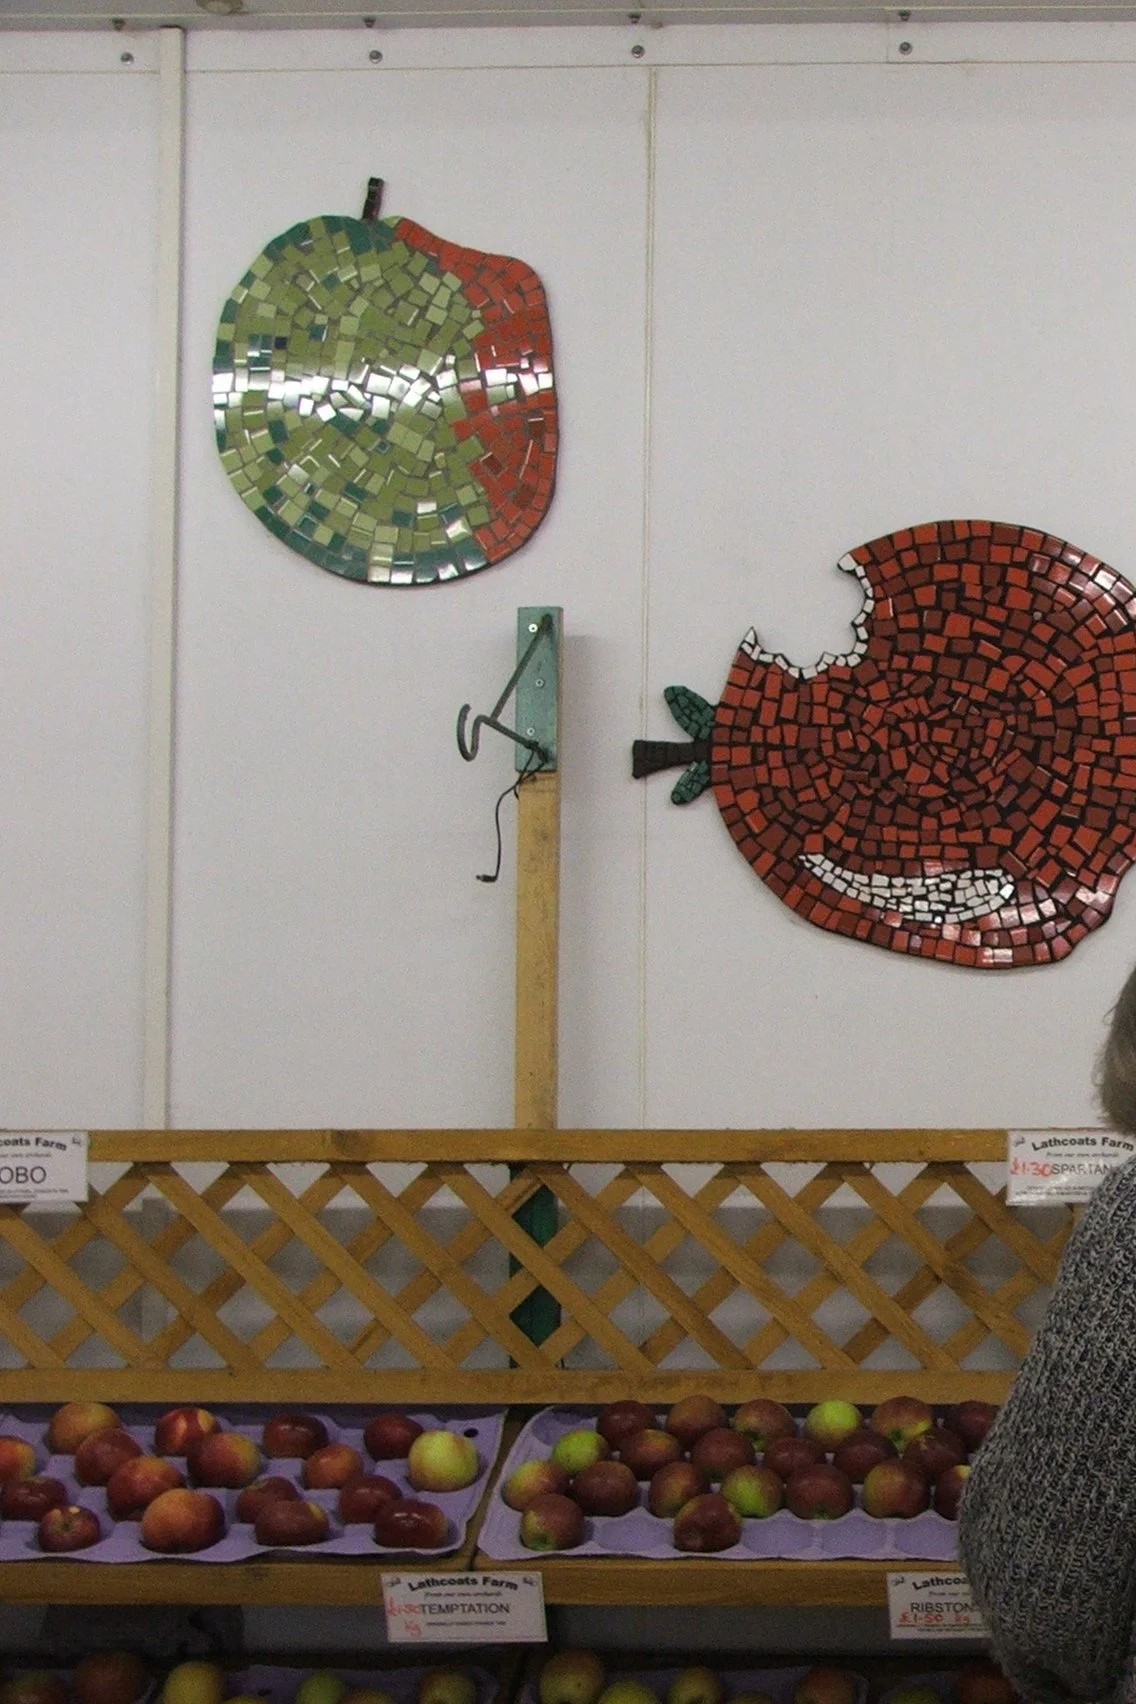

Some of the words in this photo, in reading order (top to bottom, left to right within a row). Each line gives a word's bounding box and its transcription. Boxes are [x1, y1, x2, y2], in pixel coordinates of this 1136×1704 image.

[35, 1137, 67, 1151] Farm
[1032, 1137, 1097, 1151] Lathcoats
[1101, 1137, 1134, 1151] Farm
[1051, 1163, 1113, 1175] SPARTAN
[408, 1576, 478, 1591] Lathcoats
[482, 1576, 518, 1590] Farm
[421, 1603, 511, 1614] TEMPTATION
